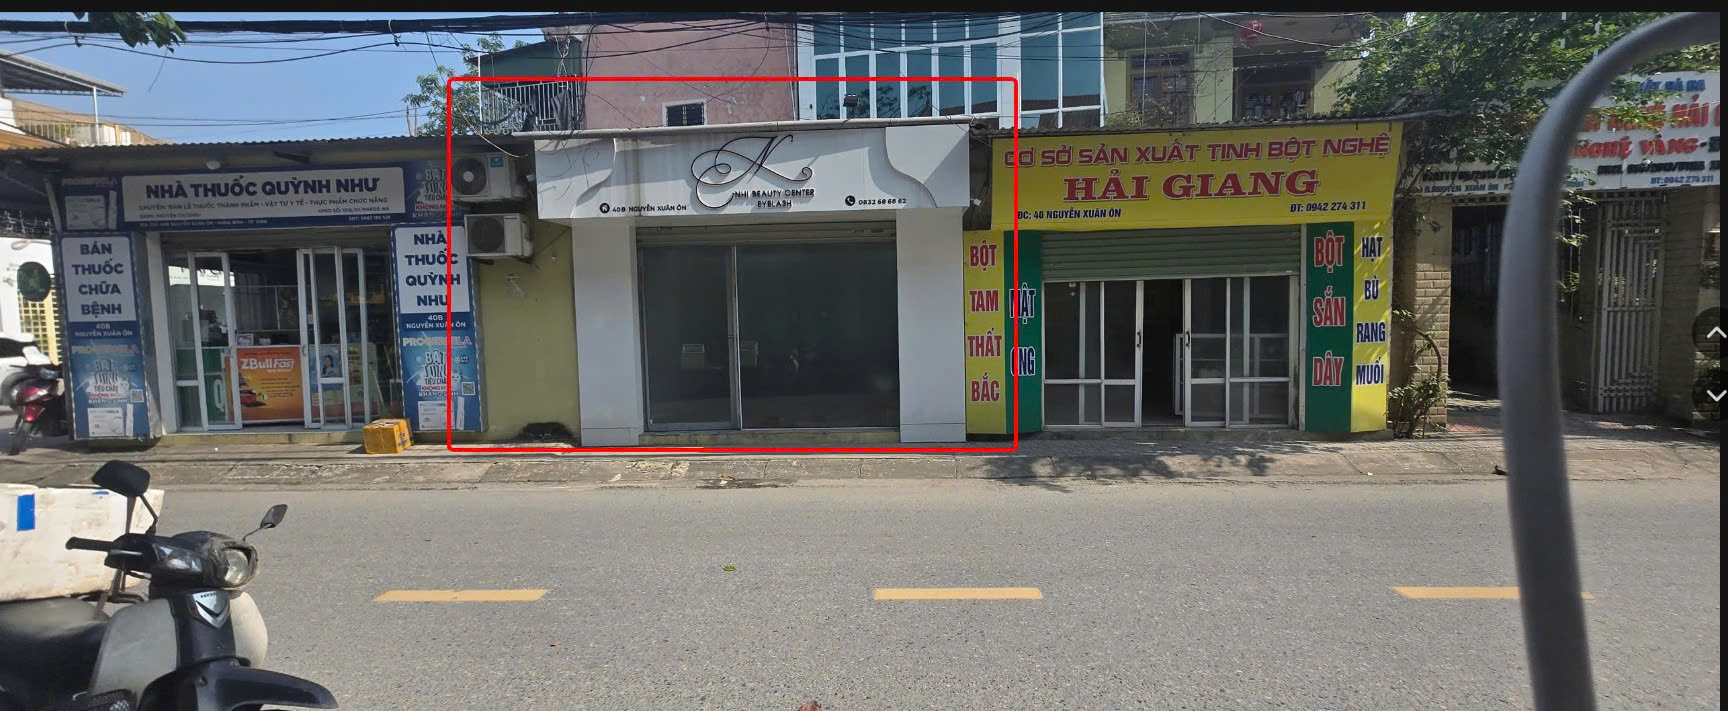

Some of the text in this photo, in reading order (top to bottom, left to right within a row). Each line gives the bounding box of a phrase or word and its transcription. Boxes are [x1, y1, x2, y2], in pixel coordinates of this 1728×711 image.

[1004, 131, 1391, 167] CƠ SỞ SẢN XUẤT TINH BỘT NGHỆ
[146, 175, 380, 199] NHÀ THUỐC QUỲNH NHƯ
[752, 189, 782, 198] BEAUTY
[784, 188, 815, 197] CENTER
[1063, 168, 1320, 203] HẢI GIANG
[656, 203, 675, 211] XUÂN
[676, 203, 687, 211] ÔN
[757, 200, 792, 208] EYELASH
[1033, 210, 1044, 219] 40
[1046, 206, 1081, 219] NGUYỄN
[1083, 207, 1106, 218] XUÂN
[1108, 206, 1122, 218] ÔN
[1290, 201, 1366, 212] ĐT: 0942 274 311
[413, 230, 449, 246] NHÀ
[80, 242, 113, 255] BÁN
[405, 247, 459, 266] THUỐC
[970, 240, 997, 272] BỘT
[1313, 229, 1345, 274] BỘT
[1361, 236, 1384, 263] HẠT
[72, 258, 124, 275] THUỐC
[79, 280, 122, 296] CHỮA
[405, 270, 461, 288] QUỲNH
[1363, 275, 1380, 301] BÙ
[81, 302, 122, 319] BỆNH
[969, 289, 999, 313] TAM
[1312, 286, 1346, 327] SẮN
[74, 328, 133, 337] NGUYỄN XUÂN ÔN
[406, 320, 466, 329] NGUYỄN XUN ÔN
[1356, 322, 1386, 344] RANG
[967, 327, 1002, 357] THẤT
[1312, 349, 1345, 387] DÂY
[1355, 356, 1385, 386] MUỐI
[971, 372, 1000, 402] BẮC
